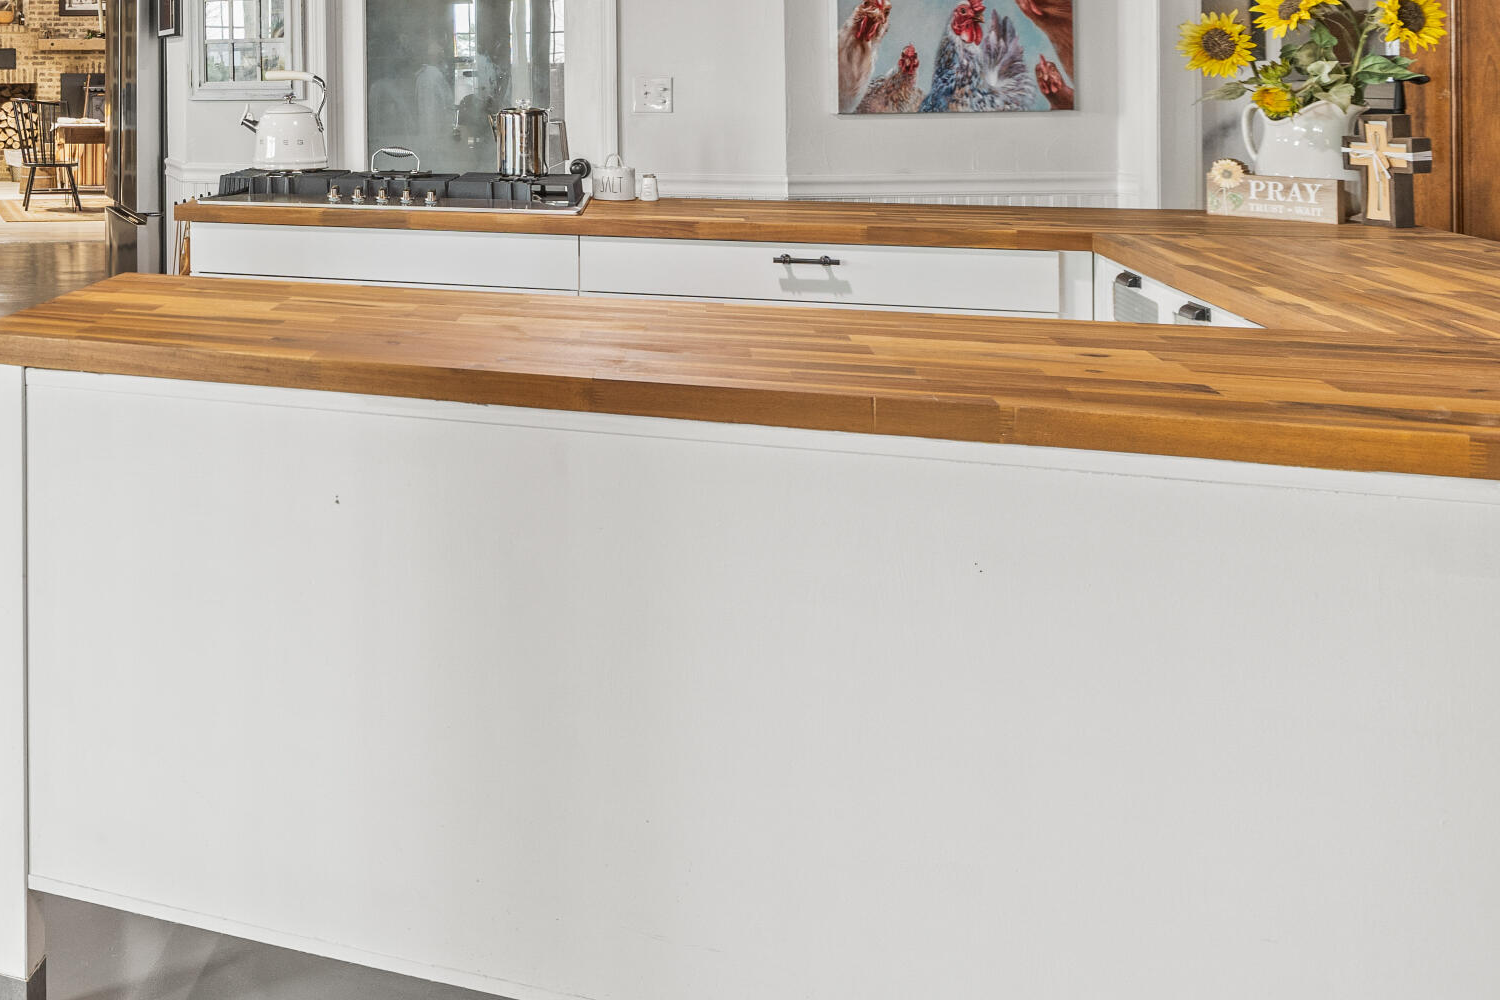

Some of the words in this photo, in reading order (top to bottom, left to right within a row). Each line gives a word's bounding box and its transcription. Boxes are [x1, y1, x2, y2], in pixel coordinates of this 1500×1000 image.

[600, 176, 624, 194] SALT
[1247, 180, 1323, 205] PRAY
[1248, 203, 1285, 214] TRUST
[1294, 206, 1324, 217] WAIT
